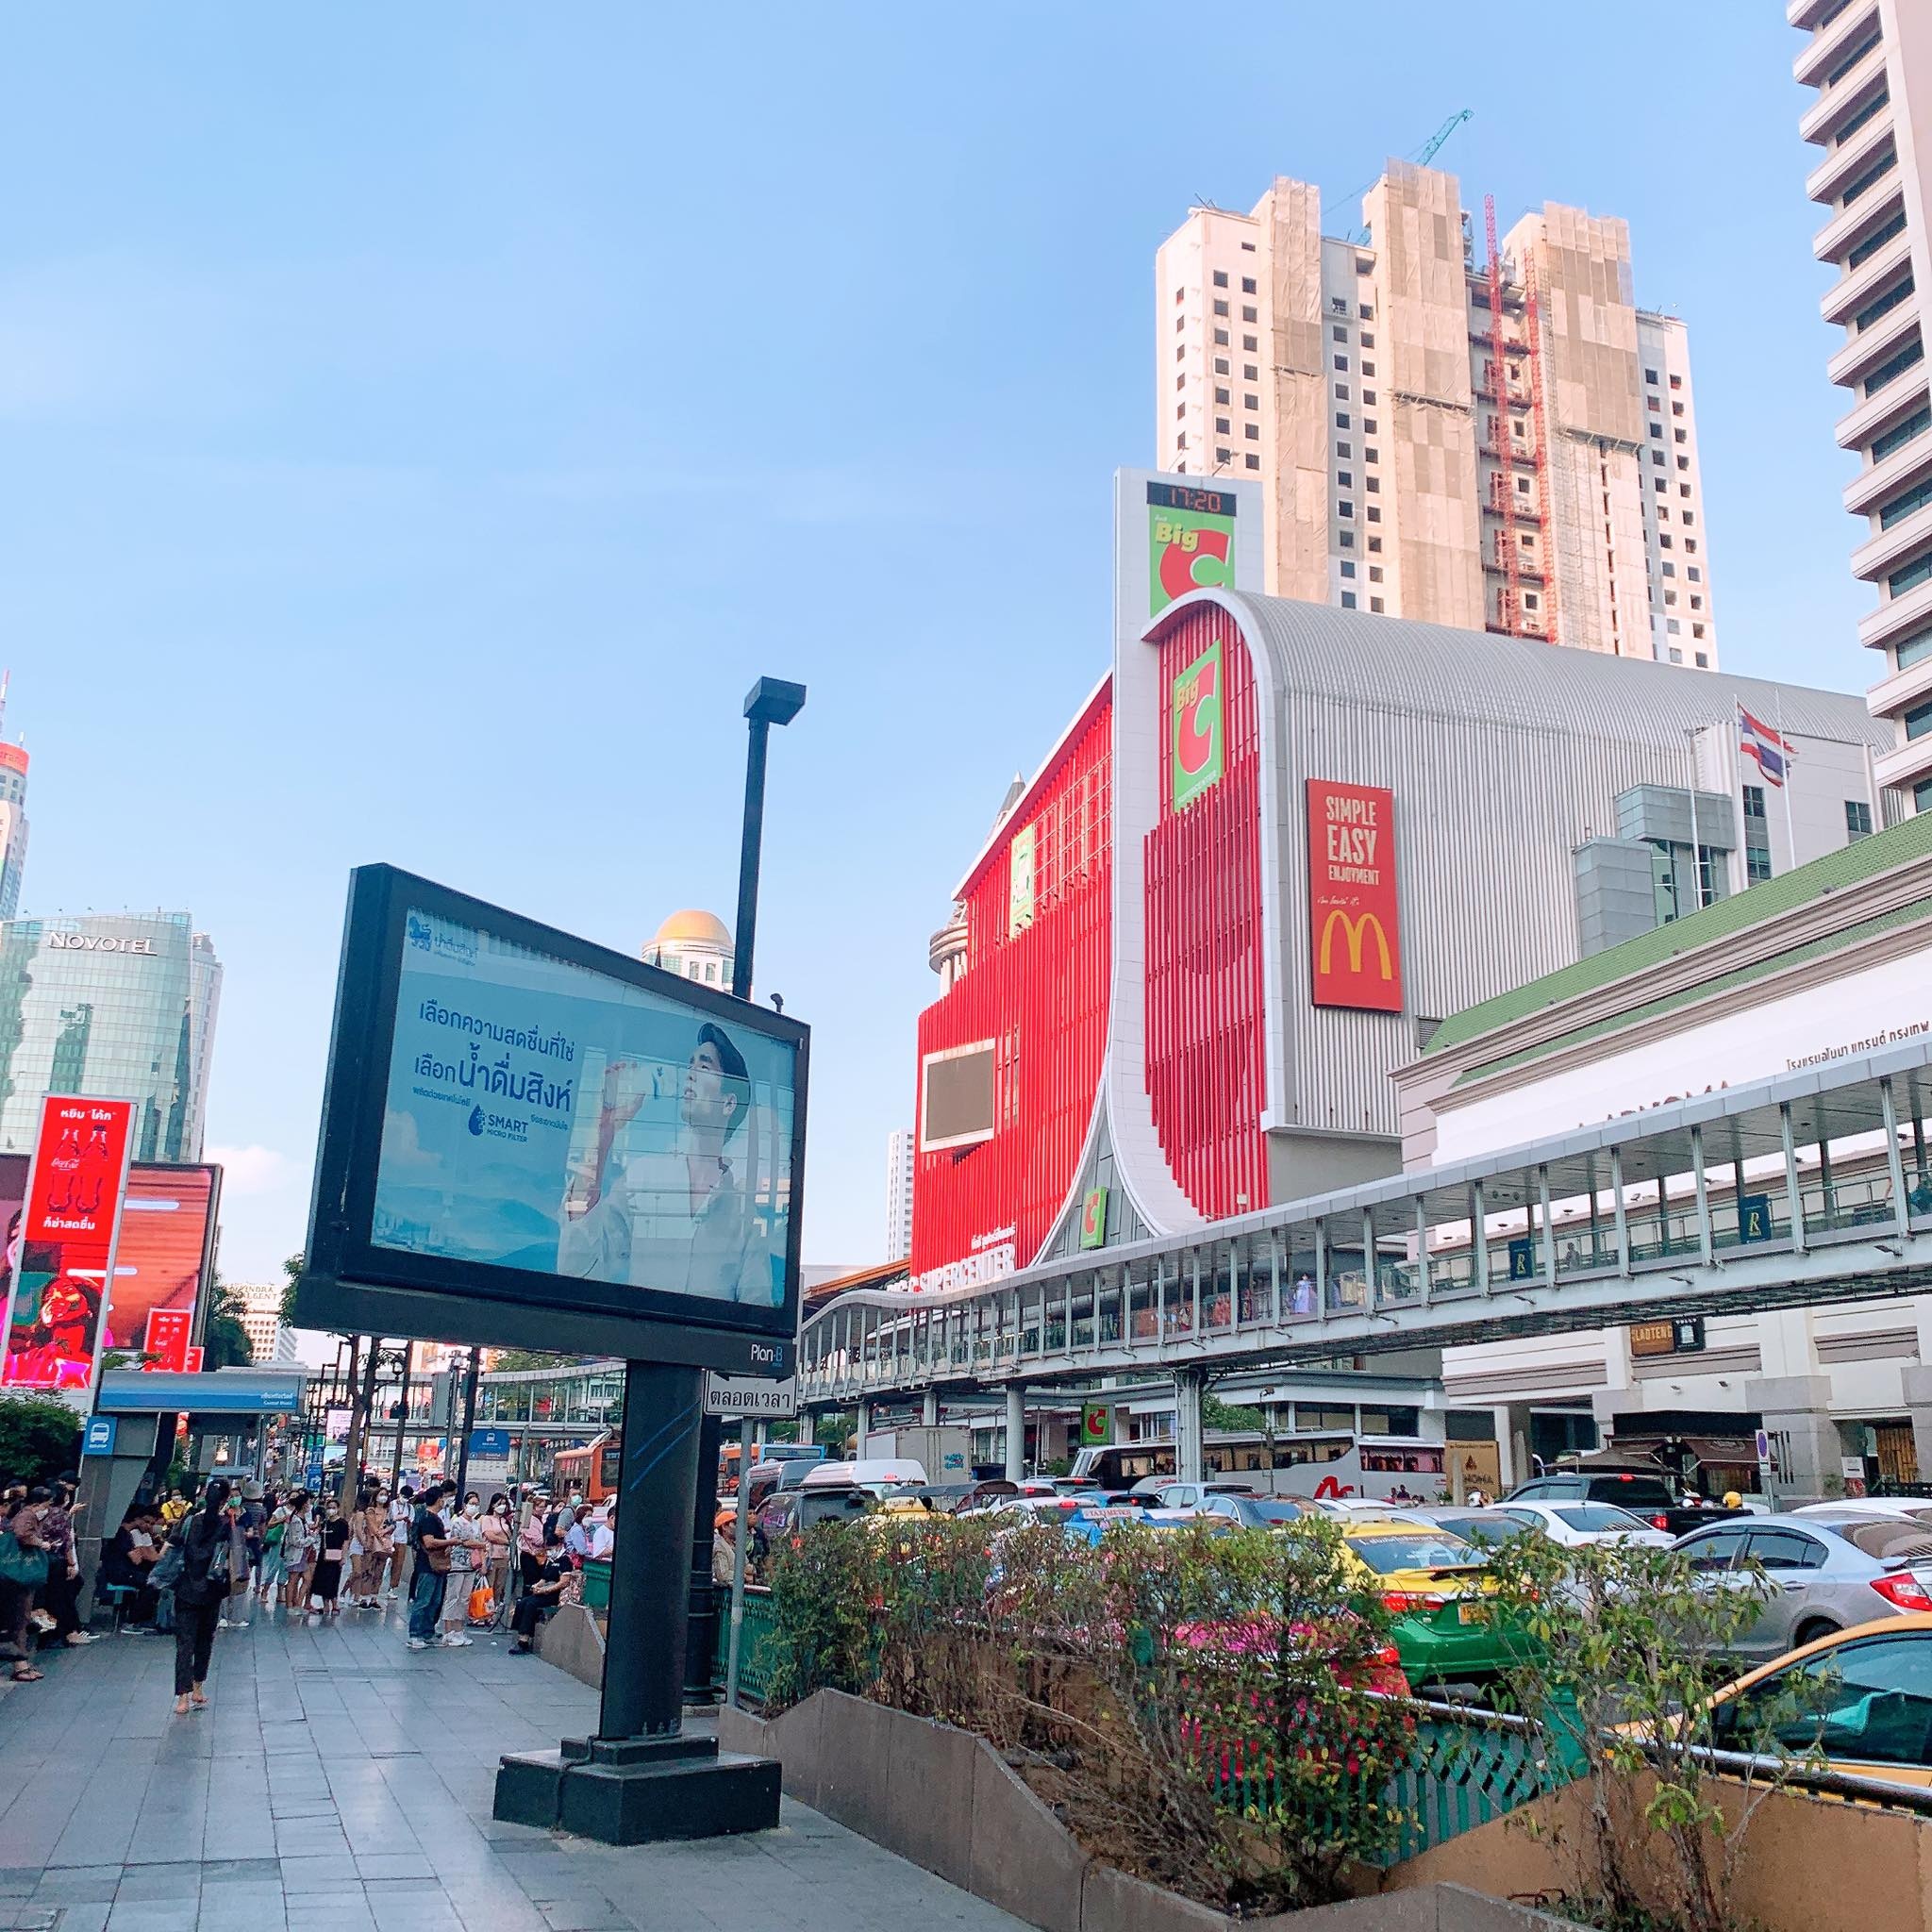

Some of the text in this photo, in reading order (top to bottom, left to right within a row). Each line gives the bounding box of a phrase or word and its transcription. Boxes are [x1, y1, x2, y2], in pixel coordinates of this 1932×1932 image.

[1170, 487, 1222, 513] 17:20
[1156, 522, 1200, 553] Big
[1159, 528, 1232, 602] C
[1176, 678, 1200, 714] Big
[1178, 659, 1217, 775] C
[1325, 795, 1377, 825] SIMPLE
[1327, 824, 1377, 865] EASY
[1328, 864, 1380, 886] ENJOYMENT
[47, 930, 158, 957] NOVOTEL
[419, 998, 575, 1062] เลือกความสดชื่นที่ใช่
[1851, 1029, 1887, 1054] แกรนด์
[1889, 1021, 1930, 1042] กรงเทพ
[487, 1128, 528, 1143] MICRO FILTER
[488, 1113, 529, 1134] SMART
[920, 1242, 1016, 1293] SUPERCENTER
[710, 1391, 791, 1408] ตลอดเวลา
